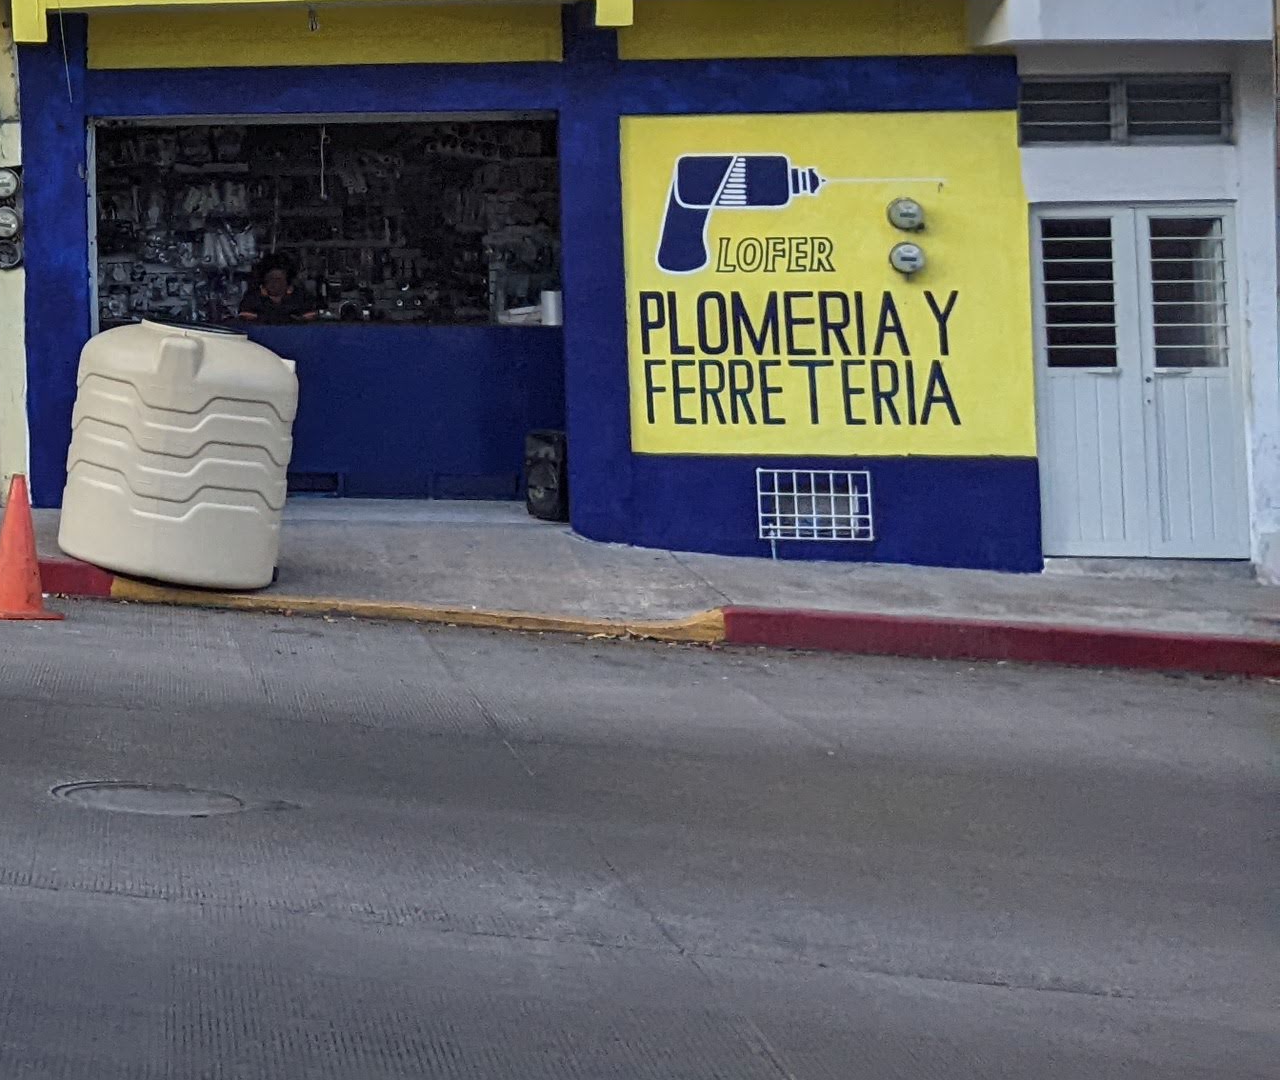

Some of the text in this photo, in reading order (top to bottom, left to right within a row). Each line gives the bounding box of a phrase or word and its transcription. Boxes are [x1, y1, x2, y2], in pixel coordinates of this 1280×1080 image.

[715, 237, 836, 273] LOFER
[639, 290, 959, 357] PLOMERIA Y
[644, 359, 962, 425] FERRETERIA
